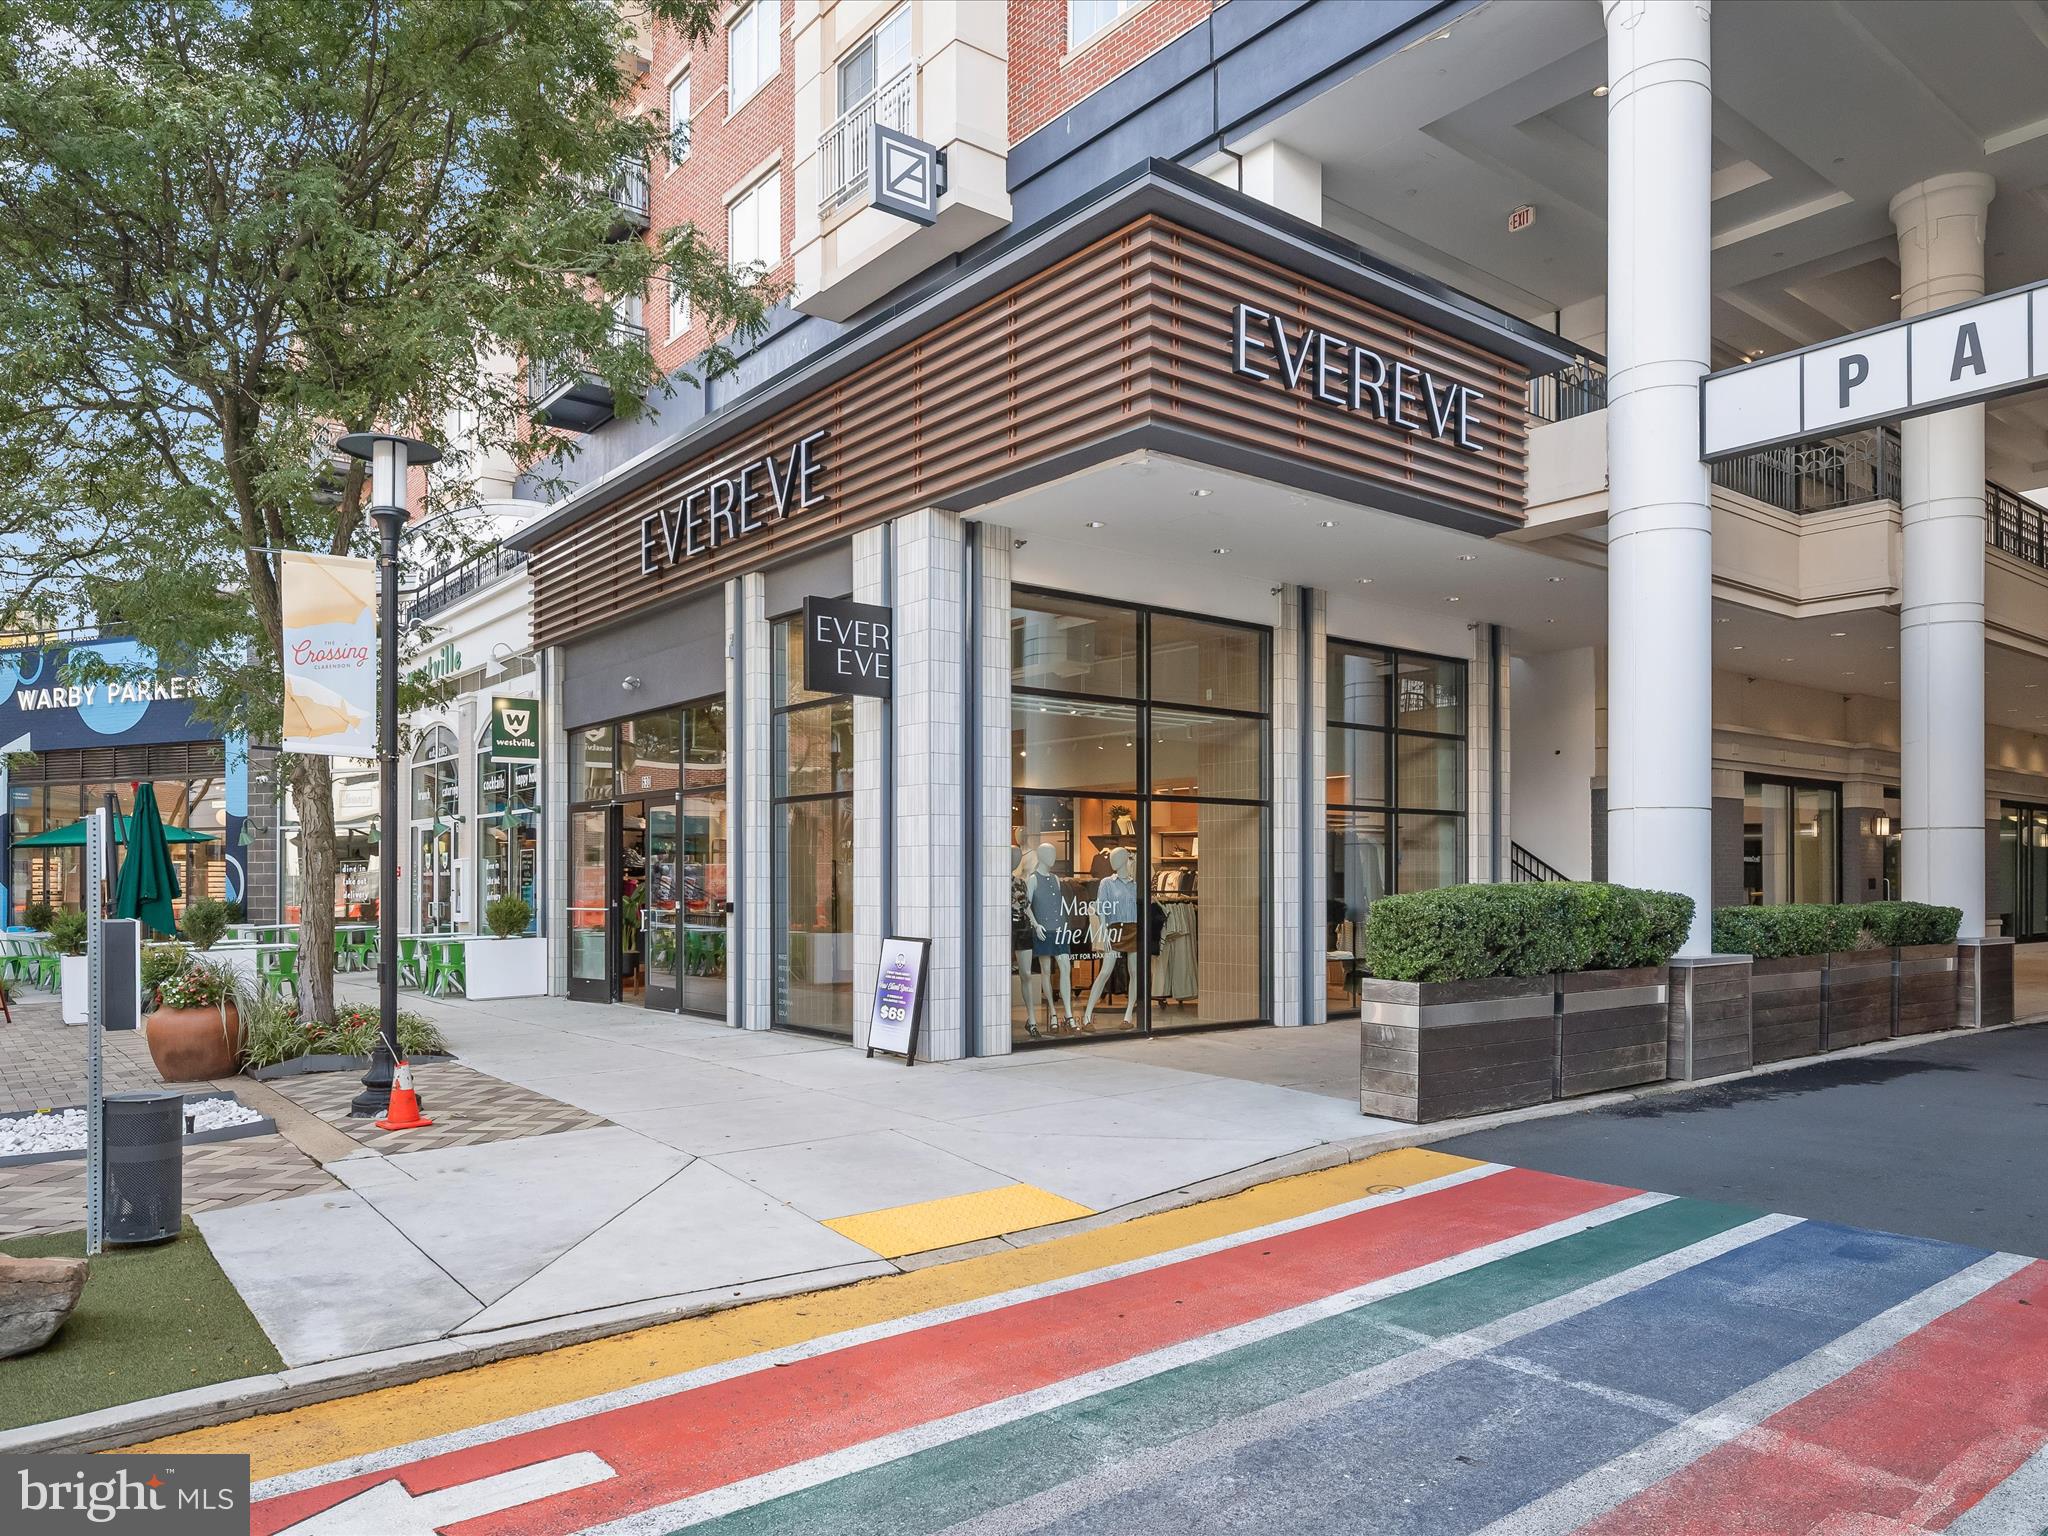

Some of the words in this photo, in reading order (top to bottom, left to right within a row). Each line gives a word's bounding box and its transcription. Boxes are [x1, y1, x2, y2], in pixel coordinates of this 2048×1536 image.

[1513, 209, 1530, 229] EXIT
[1232, 303, 1484, 451] EVEREVE
[641, 430, 830, 575] EVEREVE
[817, 615, 890, 650] EVER
[292, 640, 368, 667] Crossing
[837, 648, 890, 680] EVE
[17, 685, 97, 711] WARBY
[506, 713, 525, 726] W
[496, 738, 535, 747] westville
[483, 773, 505, 790] cocktails
[1060, 895, 1120, 916] Master
[1055, 922, 1082, 944] the
[1083, 922, 1123, 944] Mini
[880, 1004, 906, 1021] $69
